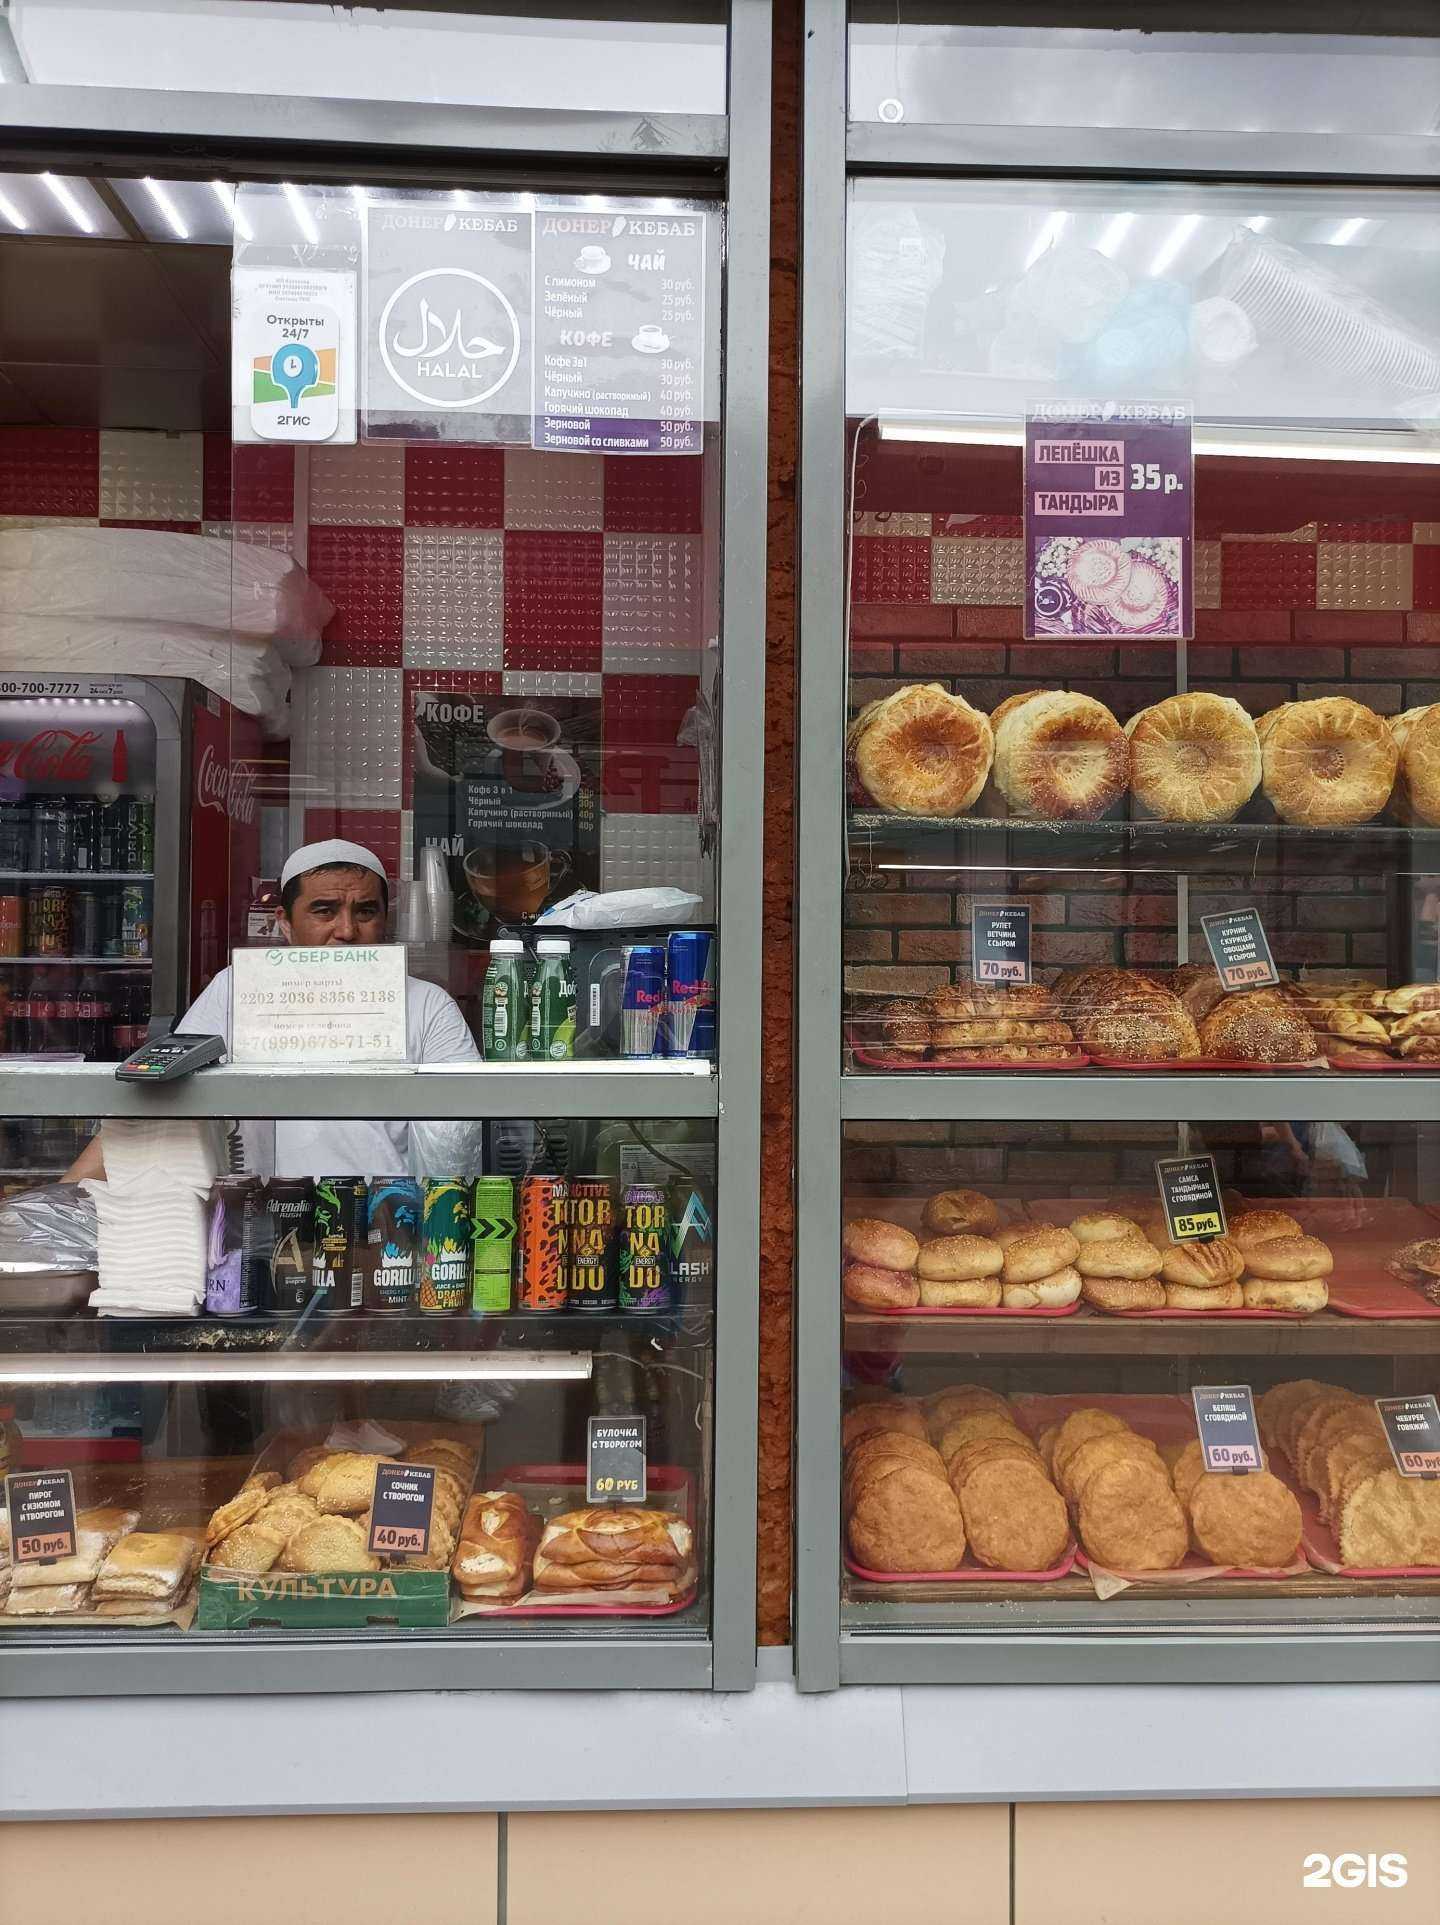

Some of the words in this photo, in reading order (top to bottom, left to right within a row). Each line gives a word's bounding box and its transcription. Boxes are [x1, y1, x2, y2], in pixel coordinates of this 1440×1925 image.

[381, 214, 443, 231] ДОНЕР
[458, 217, 519, 232] КЕБАБ
[541, 217, 611, 235] ДОНЕР
[628, 220, 696, 237] КЕБАБ
[627, 250, 666, 271] ЧАЙ
[551, 278, 596, 288] лимоном
[660, 279, 673, 290] 30
[674, 280, 695, 292] руб.
[661, 294, 673, 305] 25
[674, 295, 695, 307] руб.
[266, 314, 325, 327] Открыты
[661, 310, 673, 321] 25
[674, 310, 695, 323] руб.
[281, 328, 309, 341] 24/7
[559, 330, 613, 348] КОФЕ
[544, 355, 571, 369] Кофе
[660, 359, 673, 370] 30
[674, 359, 694, 371] руб.
[416, 361, 483, 379] HALAL
[660, 374, 673, 385] 30
[674, 375, 694, 387] руб.
[544, 386, 591, 400] Капучино
[592, 390, 651, 402] (растворимый)
[660, 390, 673, 401] 40
[674, 390, 694, 403] руб.
[544, 402, 584, 416] Горячий
[584, 404, 629, 418] шоколад
[660, 406, 673, 417] 40
[674, 406, 694, 419] руб.
[1119, 405, 1186, 420] КЕБАБ
[277, 415, 311, 427] 2ГИС
[544, 417, 591, 431] Зерновой
[660, 421, 673, 432] 50
[674, 422, 694, 434] руб.
[544, 433, 590, 447] Зерновой
[590, 436, 601, 447] со
[602, 437, 649, 448] сливками
[660, 437, 673, 448] 50
[674, 437, 694, 449] руб.
[1038, 443, 1120, 462] ЛЕПЁШКА
[1099, 470, 1121, 487] ИЗ
[1130, 463, 1161, 490] 35
[1164, 473, 1184, 494] р.
[1038, 494, 1119, 514] ТАНДЫРА
[0, 682, 80, 694] 00-700-7777
[426, 703, 484, 723] КОФЕ
[468, 784, 491, 796] Кофе
[468, 808, 508, 818] Капучино
[468, 819, 503, 829] Горячий
[505, 821, 543, 830] шоколад
[991, 921, 1012, 929] РУЛЕТ
[1221, 926, 1247, 937] КУРНИК
[987, 931, 1016, 939] ВЕТЧИНА
[1233, 951, 1257, 961] СЫРОМ
[983, 962, 999, 975] 70
[1001, 965, 1022, 978] руб.
[1227, 967, 1246, 981] 70
[1246, 966, 1268, 980] руб.
[239, 992, 275, 1005] 2202
[279, 991, 315, 1005] 2036
[319, 991, 356, 1004] 8356
[360, 990, 396, 1003] 2138
[1178, 1175, 1199, 1183] САМСА
[1171, 1182, 1210, 1194] ТАНДЫРНАЯ
[1176, 1190, 1213, 1203] ГОВЯДИНОЙ
[625, 1204, 665, 1230] TOR
[1178, 1218, 1195, 1232] 85
[1195, 1218, 1217, 1232] руб.
[630, 1232, 660, 1255] NA
[635, 1257, 654, 1265] ENERGY
[669, 1260, 709, 1276] LASH
[373, 1268, 416, 1287] GORILL
[629, 1264, 661, 1288] DO
[209, 1279, 226, 1292] RN
[1209, 1411, 1248, 1422] ГОВЯДИНОЙ
[596, 1428, 638, 1438] БУЛОЧКА
[592, 1441, 598, 1449] С
[599, 1440, 642, 1449] ТВОРОГОМ
[1212, 1448, 1230, 1462] 60
[1232, 1450, 1254, 1464] руб.
[1404, 1454, 1424, 1468] 60
[1425, 1456, 1440, 1469] руб
[391, 1481, 418, 1491] СОЧНИК
[596, 1477, 614, 1491] 60
[616, 1479, 638, 1491] РУБ
[28, 1490, 53, 1501] ПИРОГ
[383, 1492, 388, 1500] С
[388, 1492, 425, 1503] ТВОРОГОМ
[22, 1503, 27, 1511] С
[27, 1500, 61, 1510] ИЗЮМОМ
[26, 1509, 65, 1521] ТВОРОГОМ
[377, 1529, 397, 1545] 40
[397, 1533, 421, 1548] руб.
[21, 1538, 41, 1555] 50
[43, 1538, 68, 1553] руб.
[237, 1577, 398, 1601] КУЛЬТУРА
